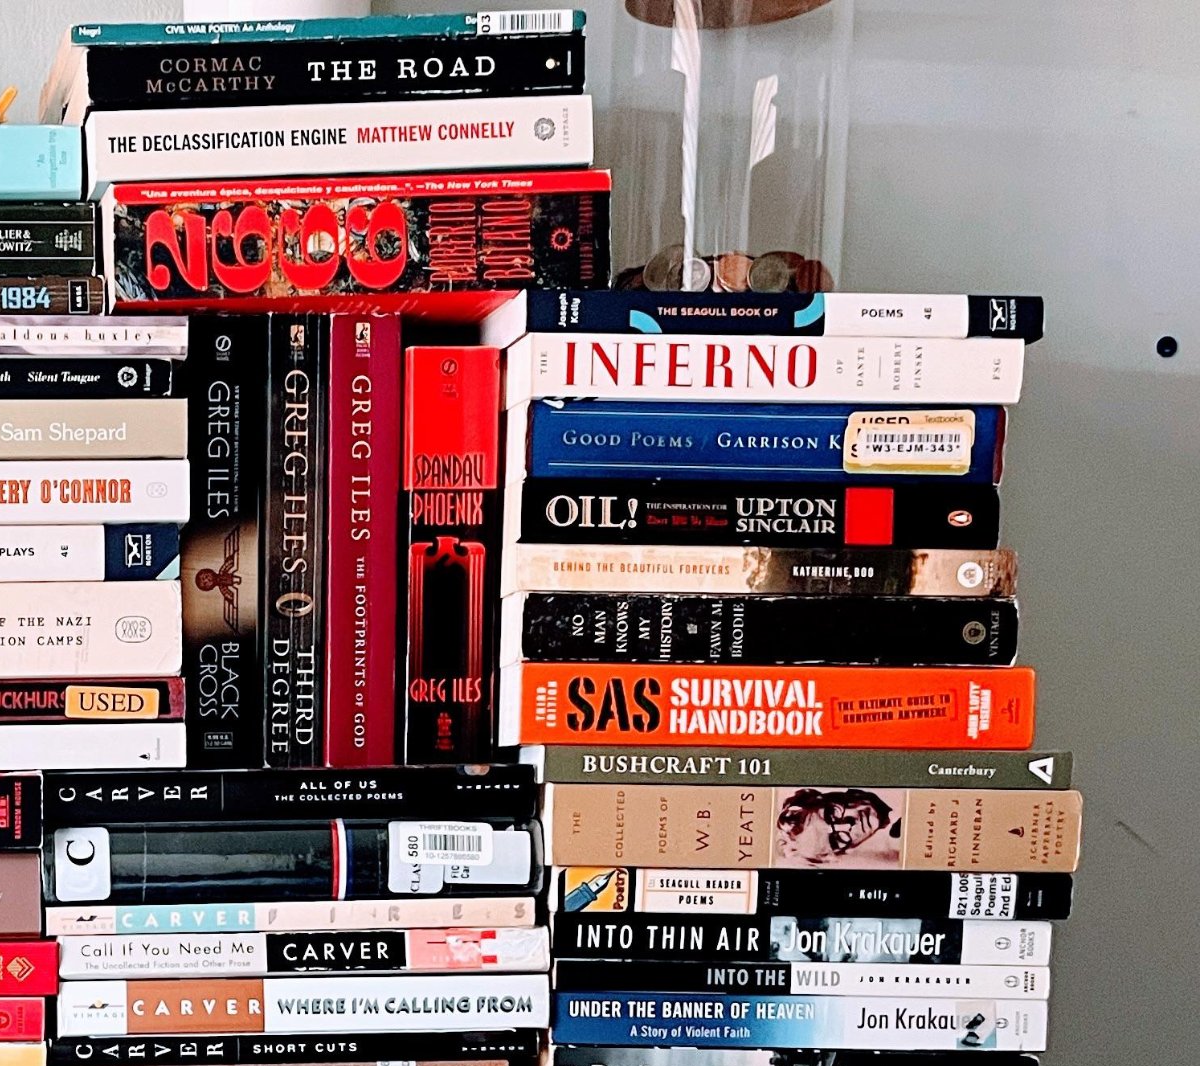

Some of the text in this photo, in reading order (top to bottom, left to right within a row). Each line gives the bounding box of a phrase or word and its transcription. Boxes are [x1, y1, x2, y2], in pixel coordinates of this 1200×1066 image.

[160, 57, 263, 74] CORMAC
[308, 57, 496, 81] THE ROAD
[108, 121, 515, 154] THE DECLASSIFICATION ENGINE MATTHEW CONNELLY
[145, 201, 409, 292] 2666
[1, 287, 50, 308] 1984
[564, 342, 817, 388] INFERNO
[1, 423, 43, 440] Sam
[49, 422, 126, 444] Shepard
[414, 454, 484, 486] SPANDAU
[41, 480, 131, 503] O'CONNOR
[413, 493, 483, 525] PHOENIX
[78, 693, 144, 713] USED
[567, 677, 660, 733] SAS
[670, 679, 823, 710] SURVIVAL
[670, 710, 823, 736] HANDBOOK
[583, 755, 771, 776] BUSHCRAFT 101
[576, 925, 759, 951] INTO THIN AIR
[783, 922, 945, 956] Jon Krakauer
